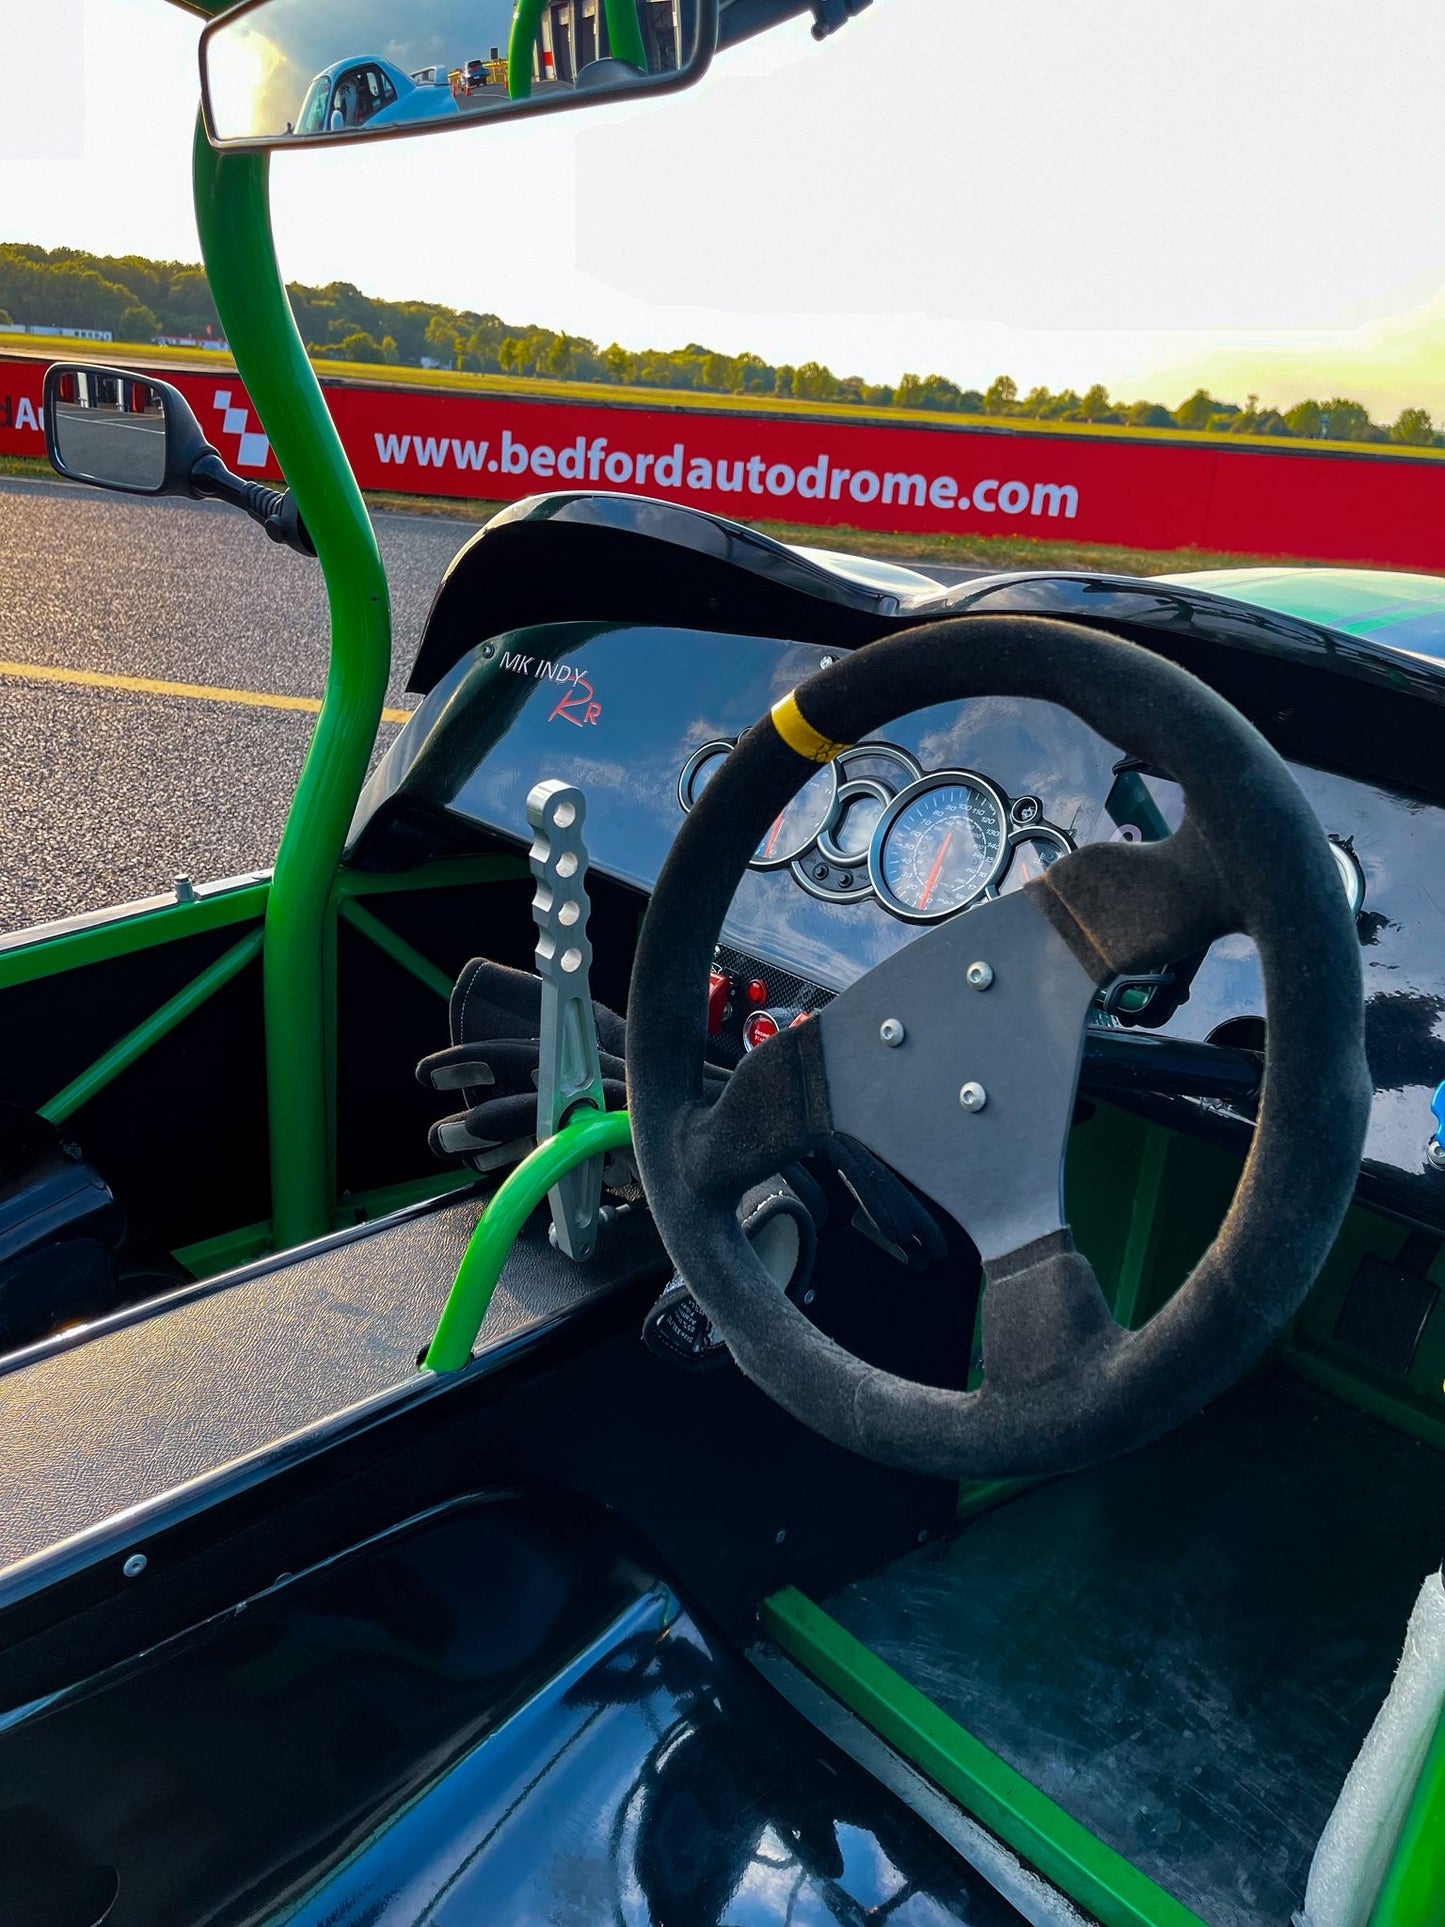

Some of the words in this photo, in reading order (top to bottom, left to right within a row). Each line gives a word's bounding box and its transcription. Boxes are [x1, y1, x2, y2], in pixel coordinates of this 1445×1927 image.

[374, 431, 1079, 518] www.bedfordautodrome.com
[499, 651, 535, 676] MK
[534, 659, 589, 687] INDY
[972, 808, 986, 816] 110
[981, 816, 995, 825] 120
[986, 828, 1000, 837] 130
